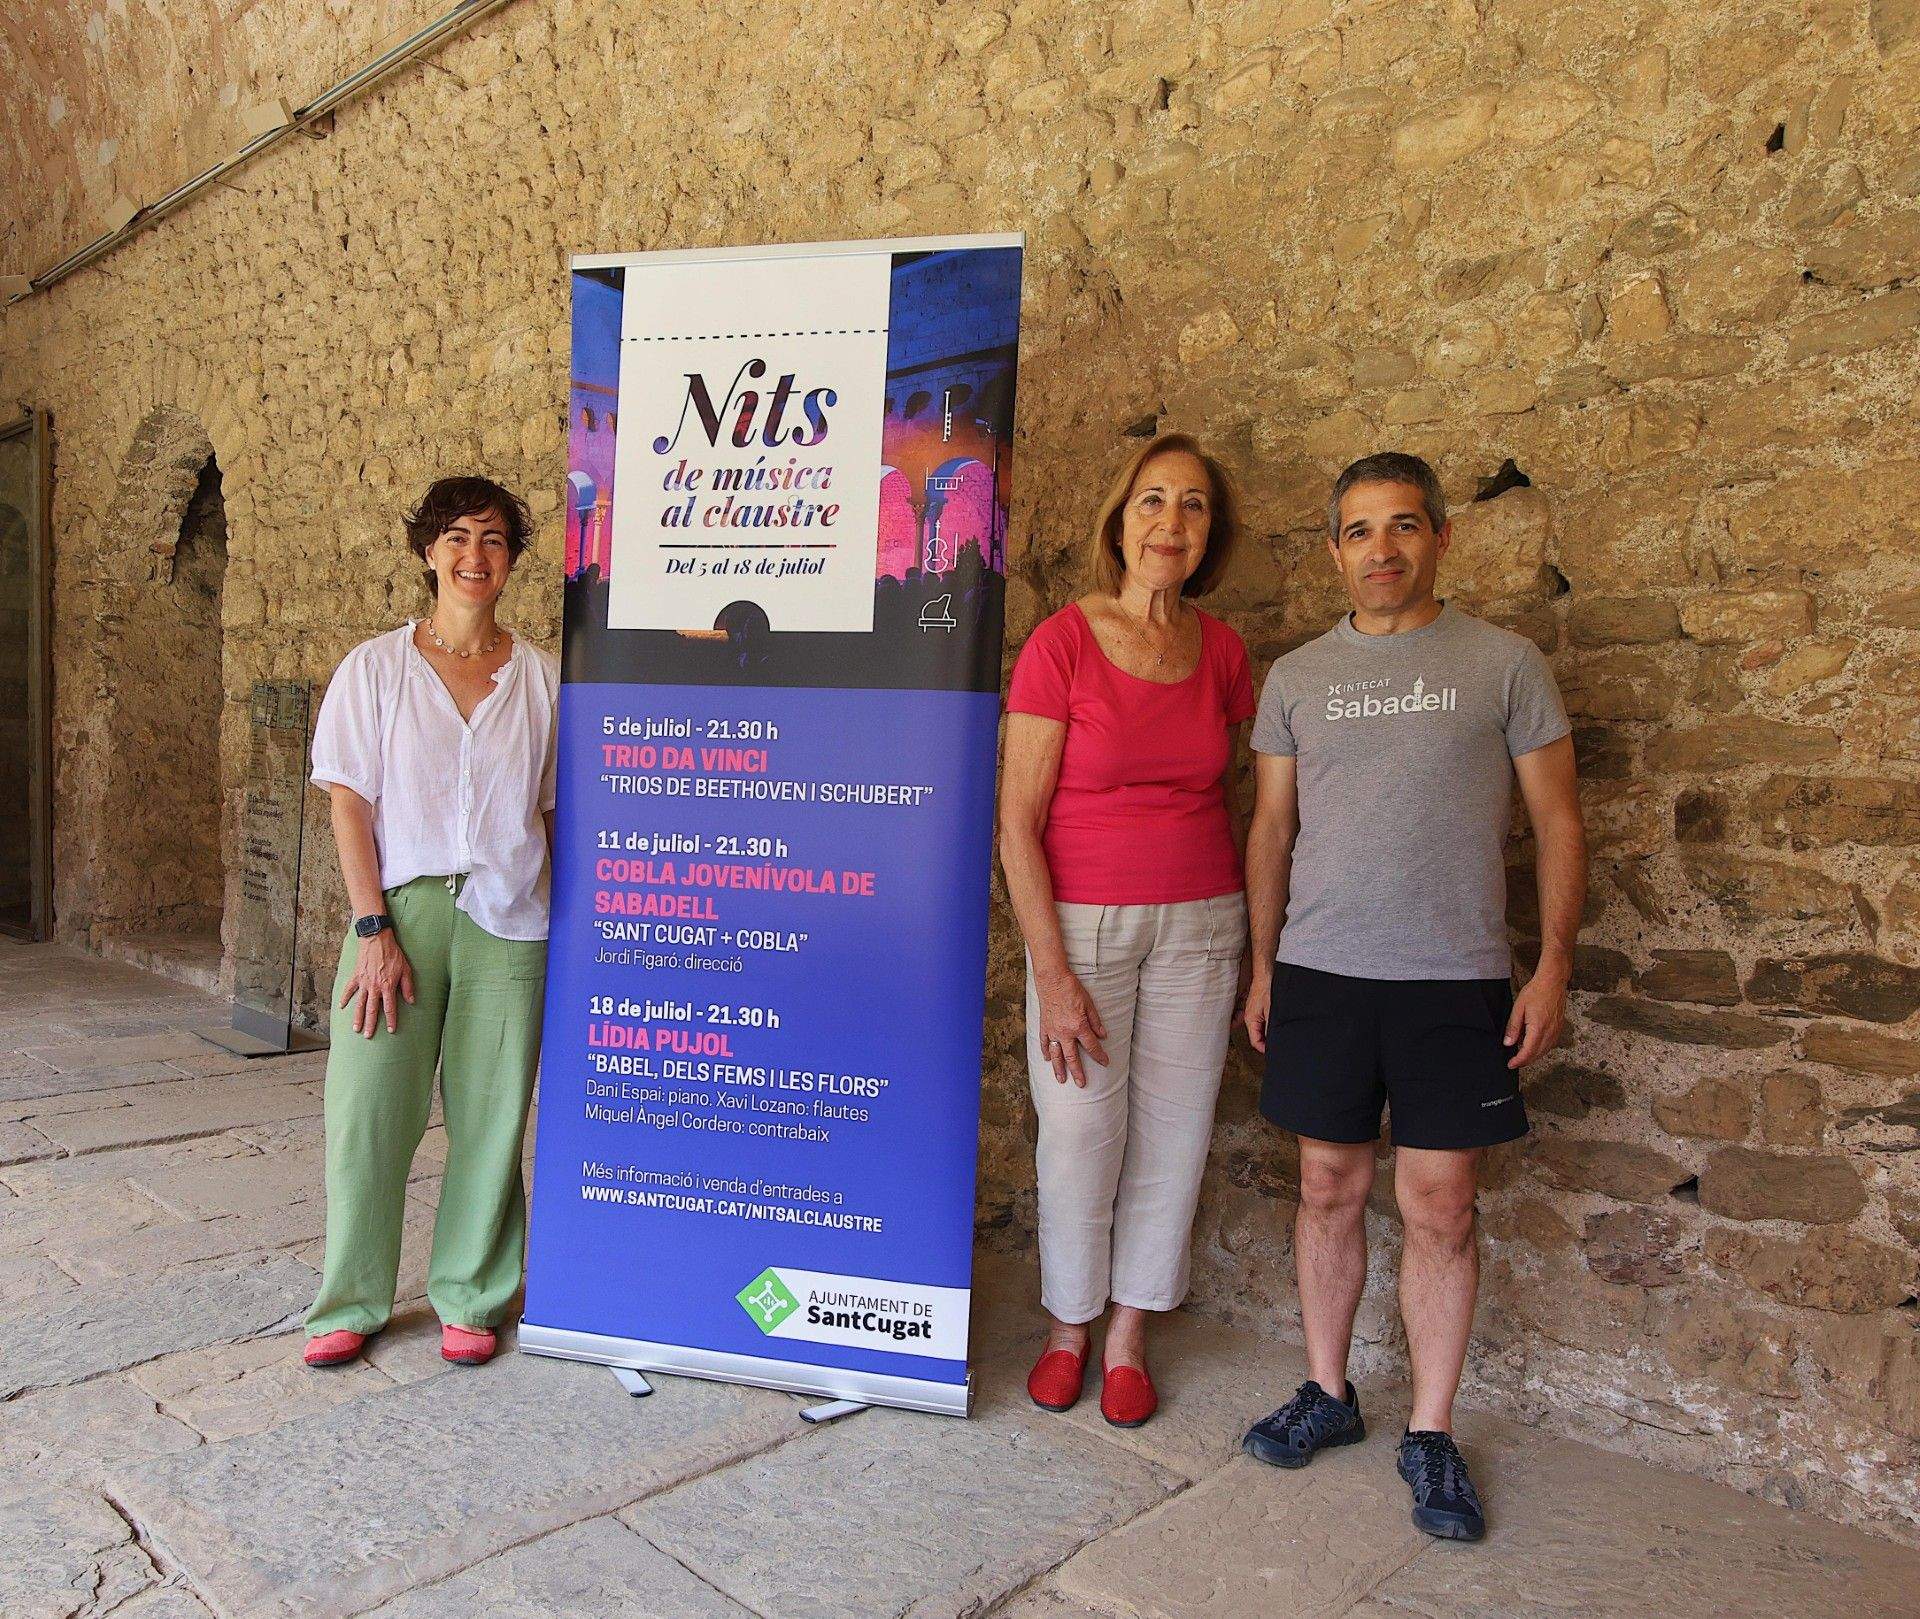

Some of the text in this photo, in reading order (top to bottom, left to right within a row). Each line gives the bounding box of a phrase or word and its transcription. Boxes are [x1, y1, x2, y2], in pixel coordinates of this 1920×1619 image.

[653, 359, 837, 454] Nits
[663, 456, 833, 491] de música
[660, 495, 840, 527] al claustre
[665, 558, 825, 578] Del 5 al 18 de juliol
[1325, 680, 1457, 721] Sabadell
[1343, 679, 1391, 693] INTECAT
[603, 716, 614, 735] 5
[619, 717, 642, 736] de
[643, 718, 691, 740] juliol
[707, 720, 762, 740] 21.30
[767, 721, 778, 740] h
[602, 744, 768, 772] TRIO DA VINCI
[600, 775, 933, 806] “TRIOS DE BEETHOVEN I SCHUBERT”
[597, 831, 621, 849] 11
[626, 832, 649, 850] de
[651, 833, 700, 855] juliol
[715, 836, 771, 857] 21.30
[776, 838, 788, 858] h
[596, 858, 876, 896] COBLA JOVENÍVOLA DE
[595, 890, 719, 920] SABADELL
[594, 920, 808, 952] “SANT CUGAT + COBLA”
[595, 947, 743, 973] Jordi Figaró: direcció
[589, 995, 614, 1015] 18
[618, 998, 641, 1017] de
[643, 1000, 692, 1022] juliol
[707, 1005, 763, 1027] 21.30
[767, 1009, 780, 1028] h
[588, 1021, 734, 1057] LÍDIA PUJOL
[588, 1053, 889, 1098] “BABEL, DELS FEMS I LES FLORS”
[586, 1079, 618, 1098] Dani
[622, 1083, 665, 1105] Espai:
[716, 1091, 748, 1110] Xavi
[752, 1094, 809, 1116] Lozano:
[813, 1100, 869, 1122] flautes
[585, 1103, 830, 1143] Miquel Àngel Cordero: contrabaix
[582, 1161, 842, 1204] Més informació i venda d’entrades a
[582, 1186, 883, 1233] WWW.SANTCUGAT.CAT/NITSALCLAUSTRE
[808, 1290, 933, 1318] AJUNTAMENT DE
[807, 1305, 932, 1341] SantCugat
